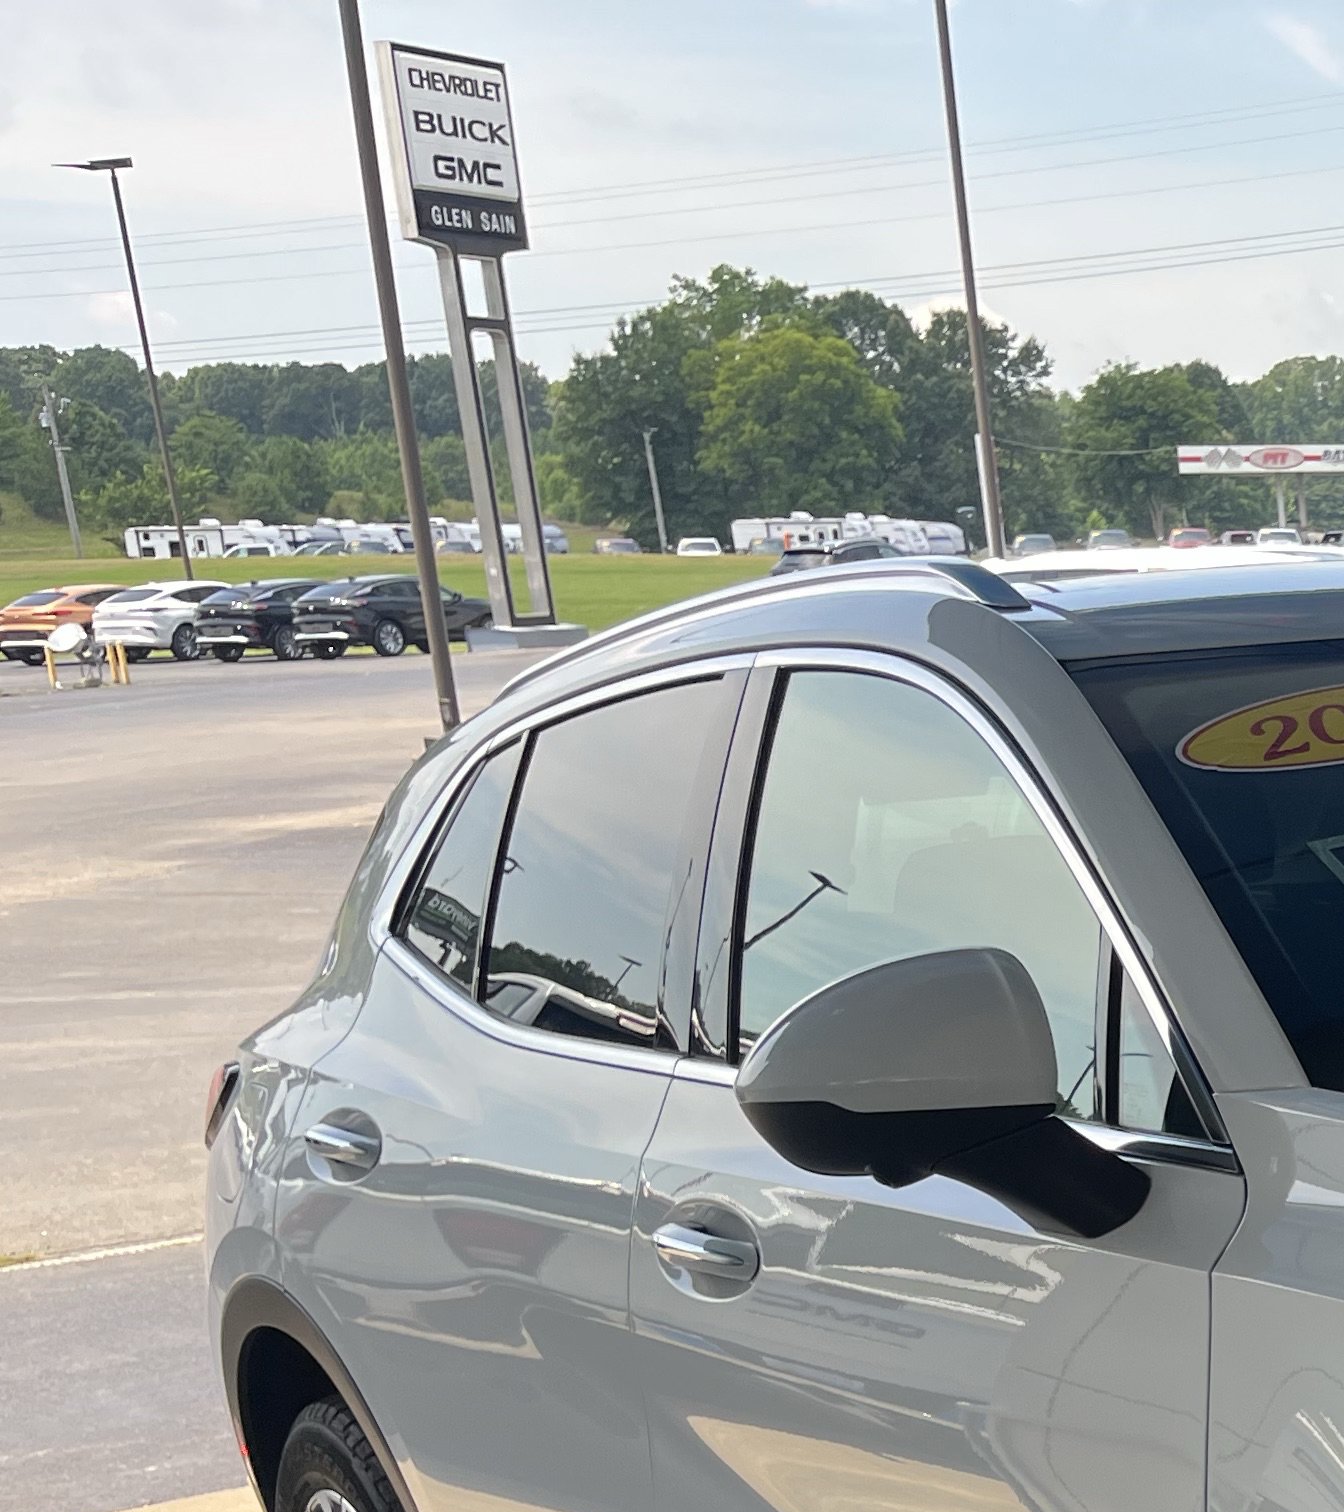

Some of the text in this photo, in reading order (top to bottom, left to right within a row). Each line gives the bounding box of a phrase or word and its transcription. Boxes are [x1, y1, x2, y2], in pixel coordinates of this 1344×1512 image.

[408, 67, 501, 102] CHEVROLET
[413, 110, 510, 146] BUICK
[433, 154, 503, 188] GMC
[430, 204, 516, 235] GLEN SAIN
